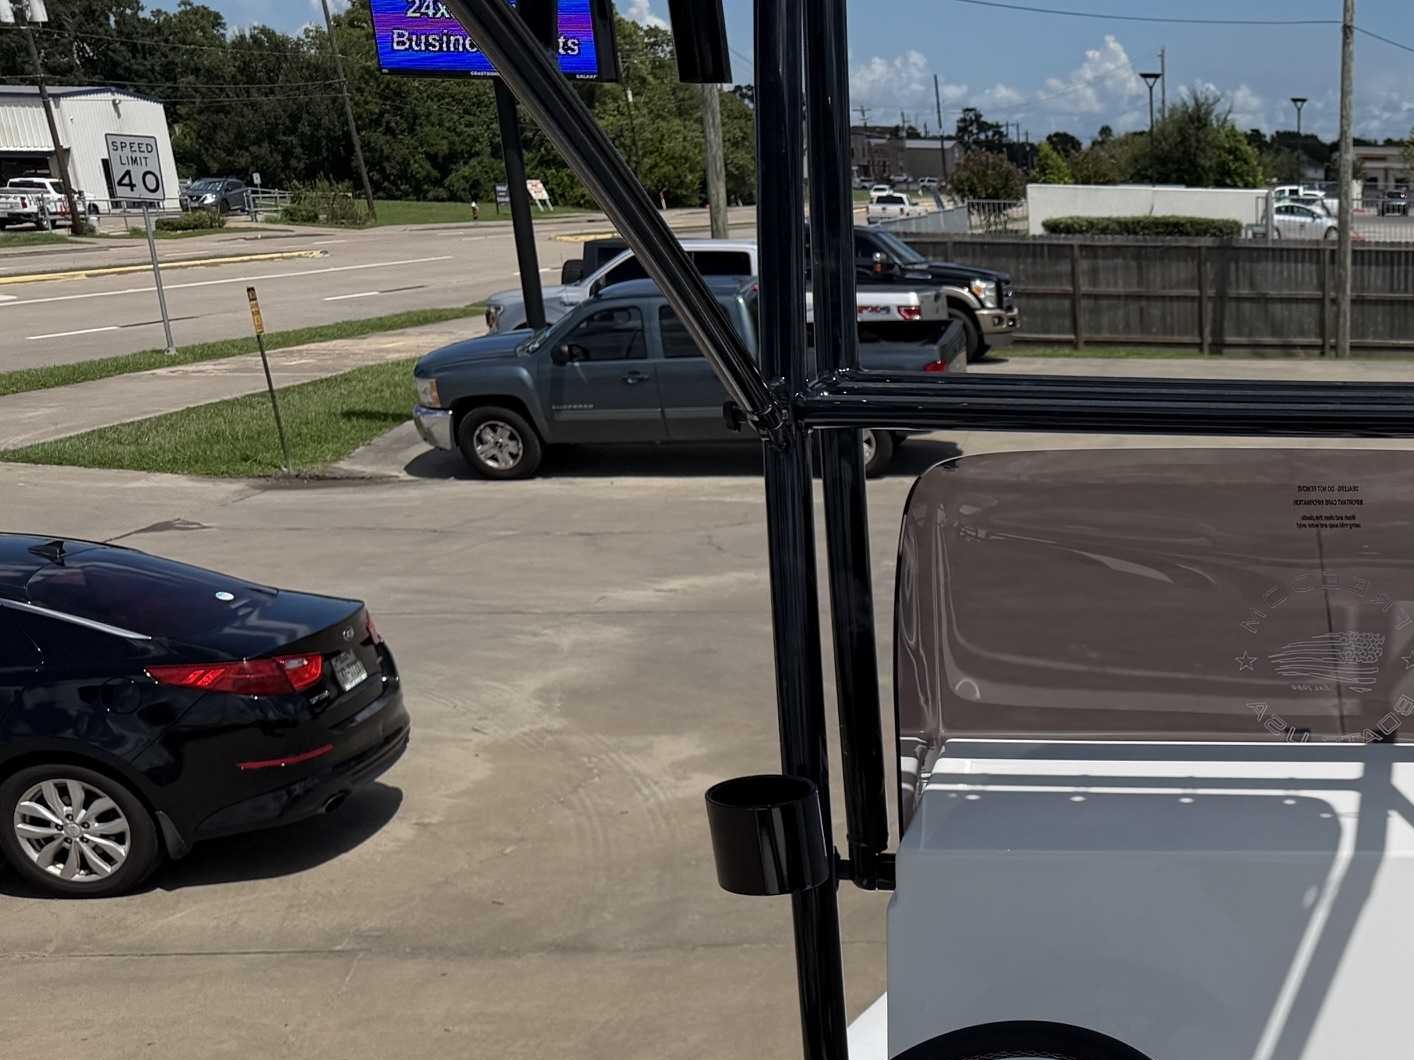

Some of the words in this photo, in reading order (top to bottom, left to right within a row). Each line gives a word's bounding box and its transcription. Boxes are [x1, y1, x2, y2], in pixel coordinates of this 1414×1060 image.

[392, 30, 480, 52] Busin
[111, 140, 154, 154] SPEED
[119, 154, 149, 168] LIMIT
[116, 168, 160, 194] 40
